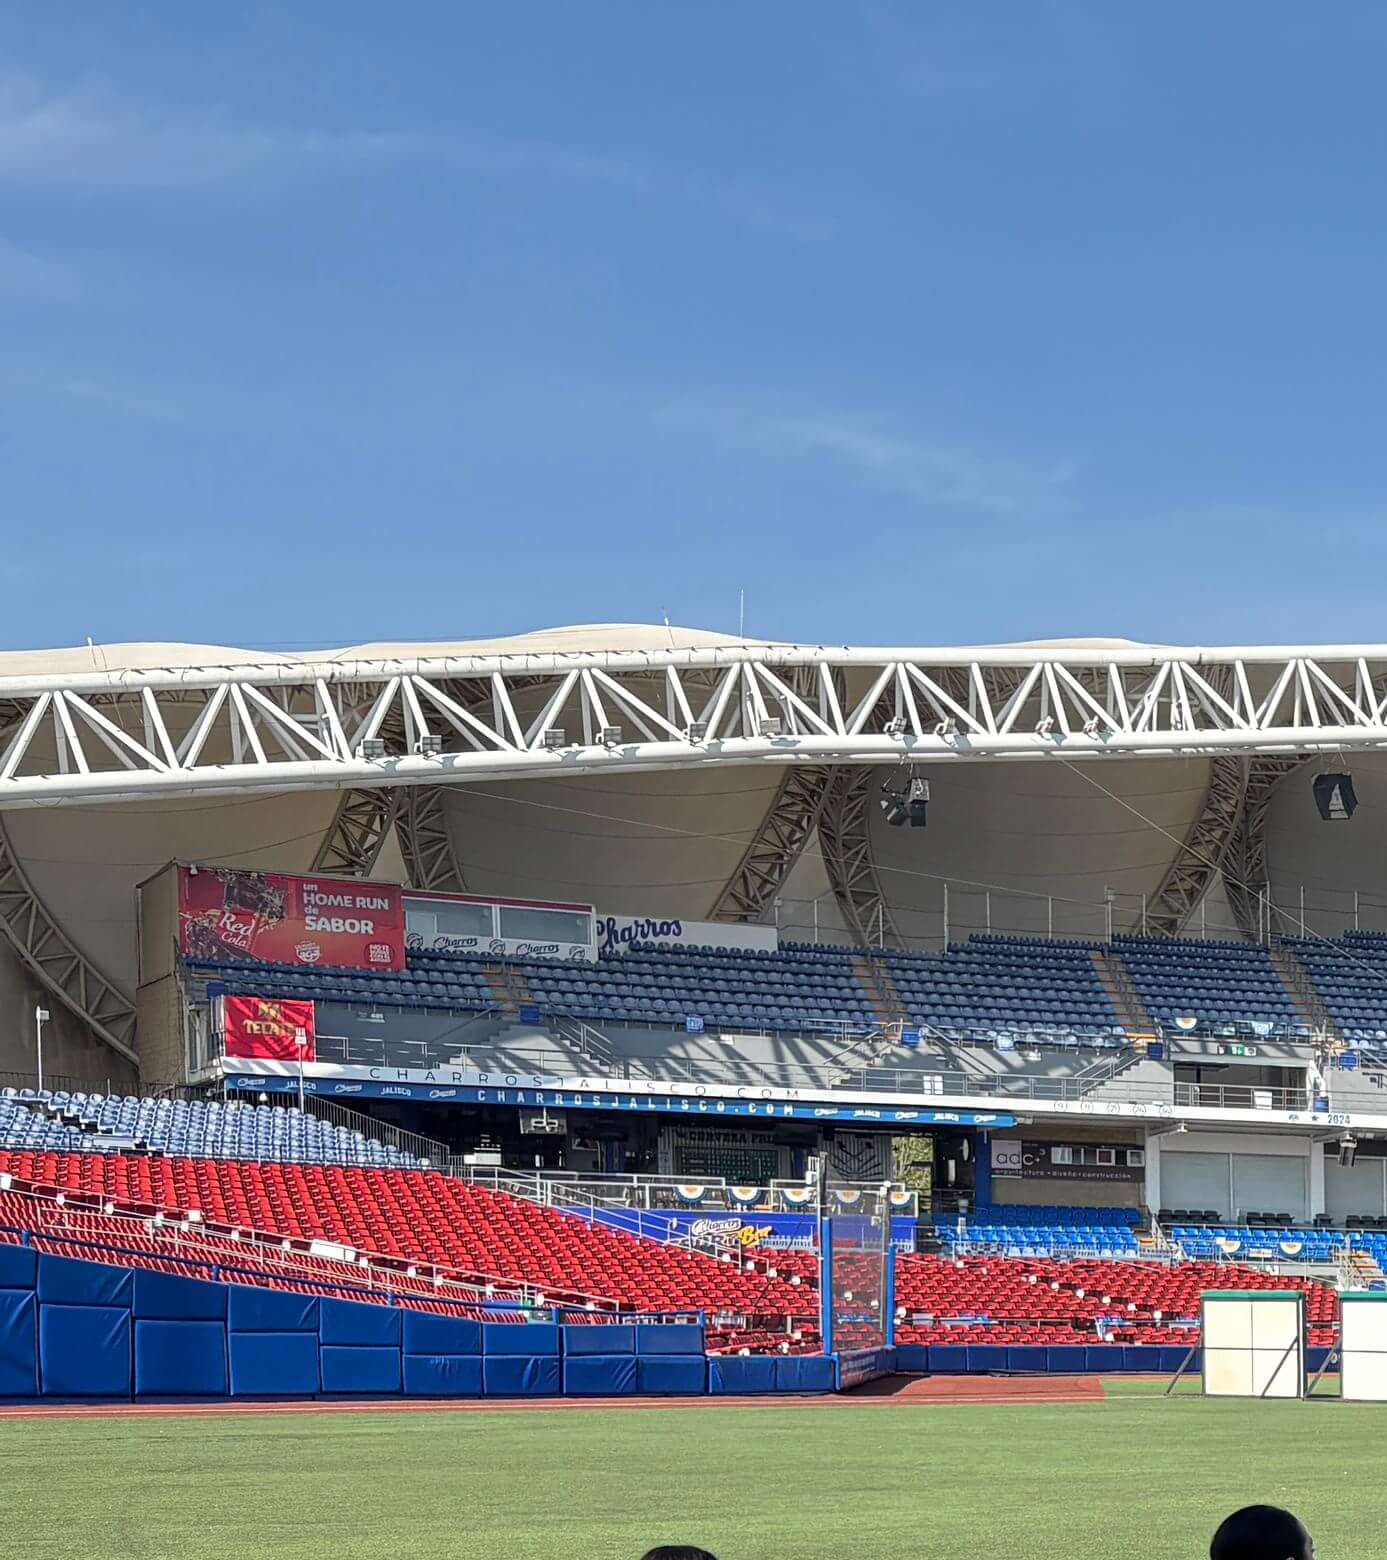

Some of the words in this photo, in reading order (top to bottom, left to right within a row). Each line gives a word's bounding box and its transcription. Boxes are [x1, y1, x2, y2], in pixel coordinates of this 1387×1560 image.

[303, 884, 317, 892] un
[303, 893, 352, 907] HOME
[355, 896, 389, 910] RUN
[304, 905, 319, 916] de
[218, 911, 255, 937] Red
[304, 917, 374, 934] SABOR
[221, 932, 247, 948] Cola
[433, 936, 477, 950] Charros
[515, 943, 559, 956] Charros
[477, 1089, 794, 1117] CHARROSJALISCO.COM
[1328, 1114, 1350, 1125] 2024
